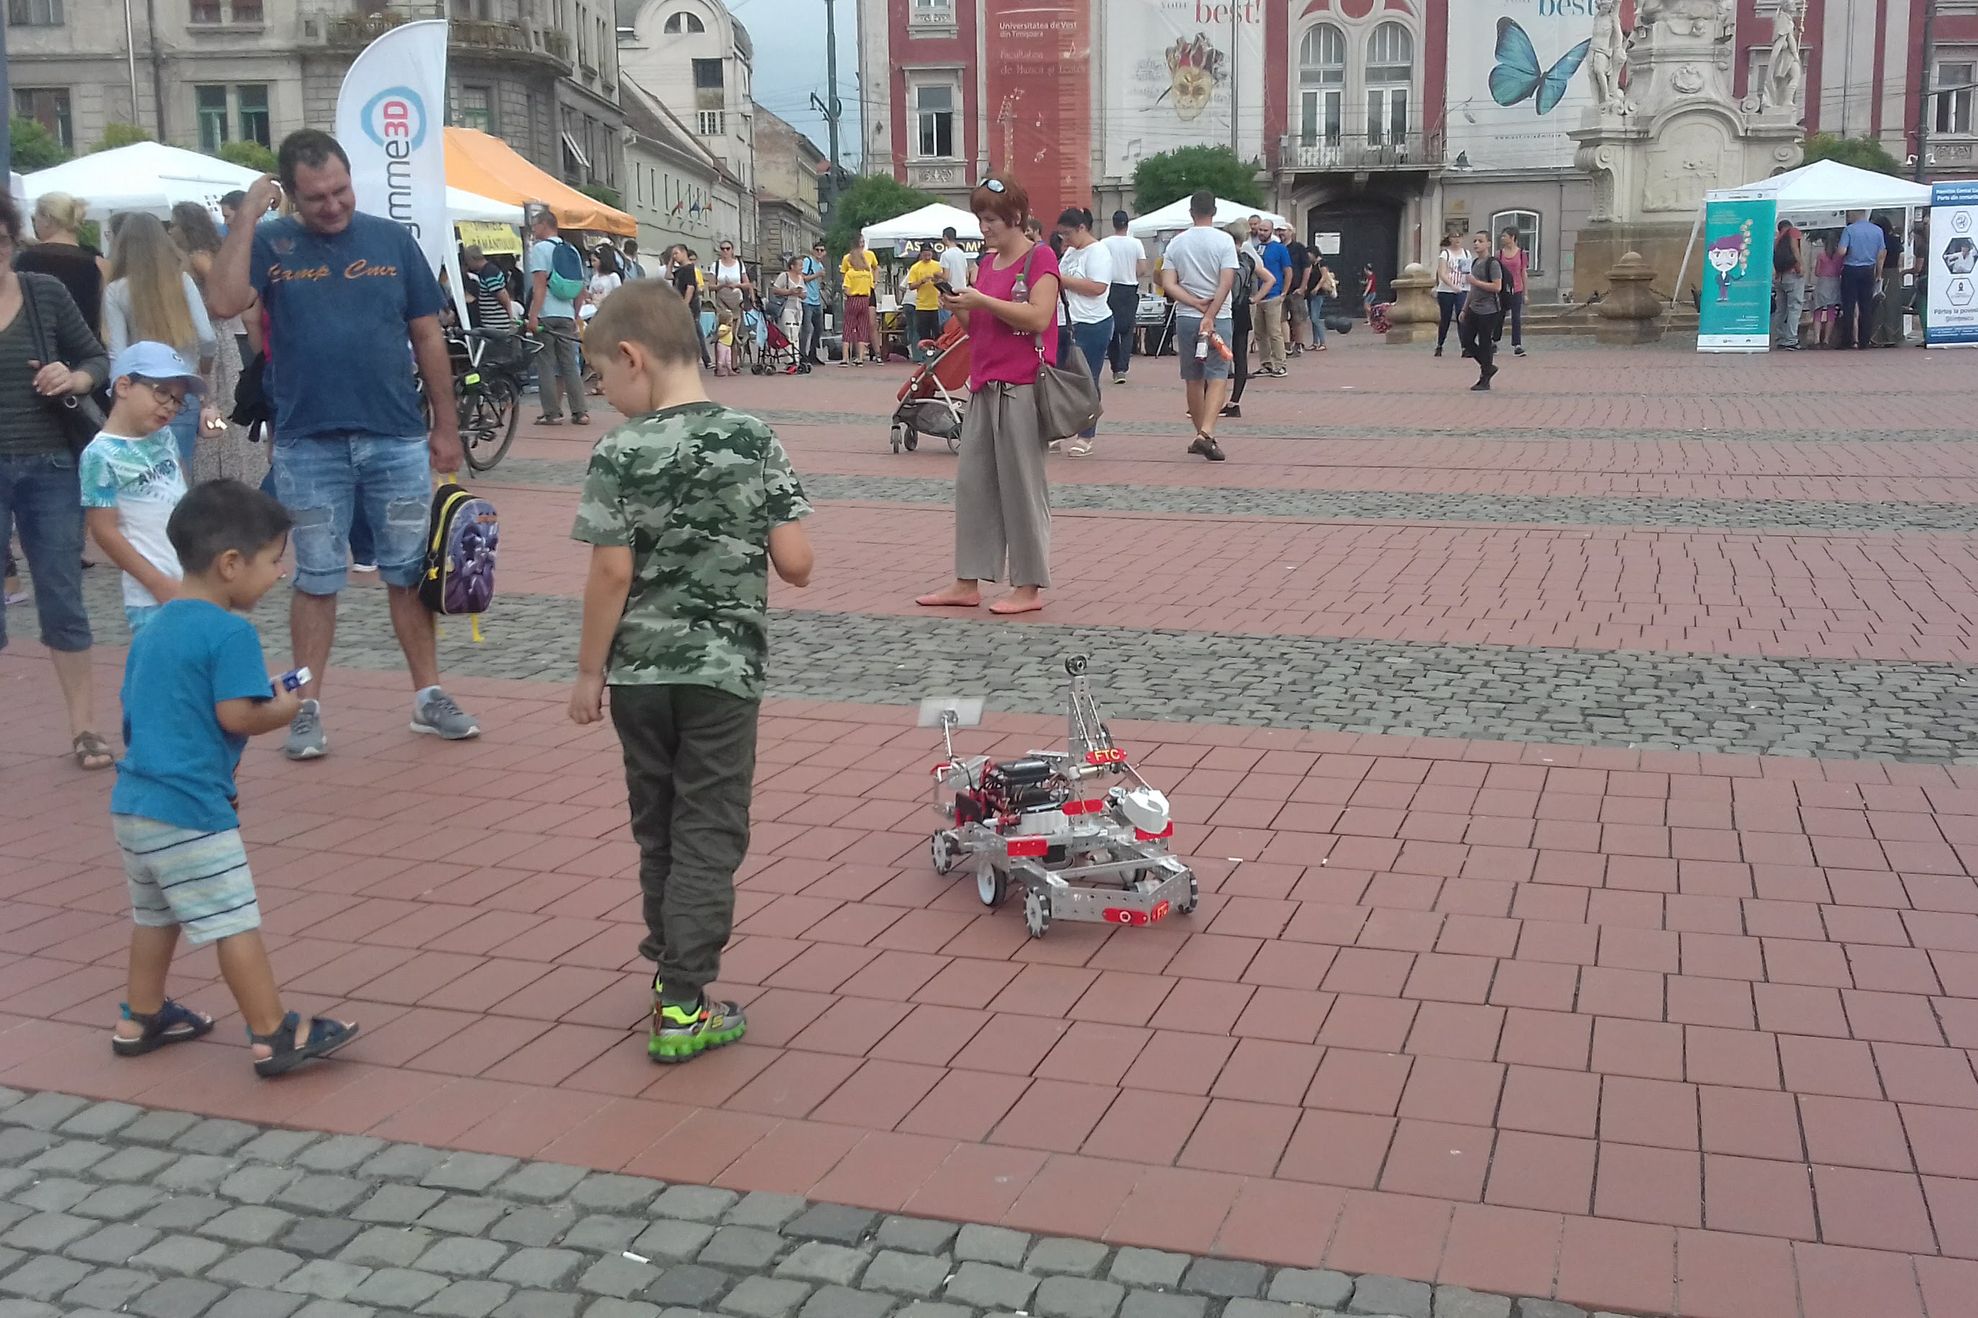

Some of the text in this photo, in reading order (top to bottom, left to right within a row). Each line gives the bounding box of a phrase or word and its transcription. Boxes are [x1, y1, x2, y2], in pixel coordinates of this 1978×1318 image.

[1195, 0, 1261, 24] best!
[999, 21, 1077, 30] Universitatea de Vest
[1094, 748, 1121, 762] FTC
